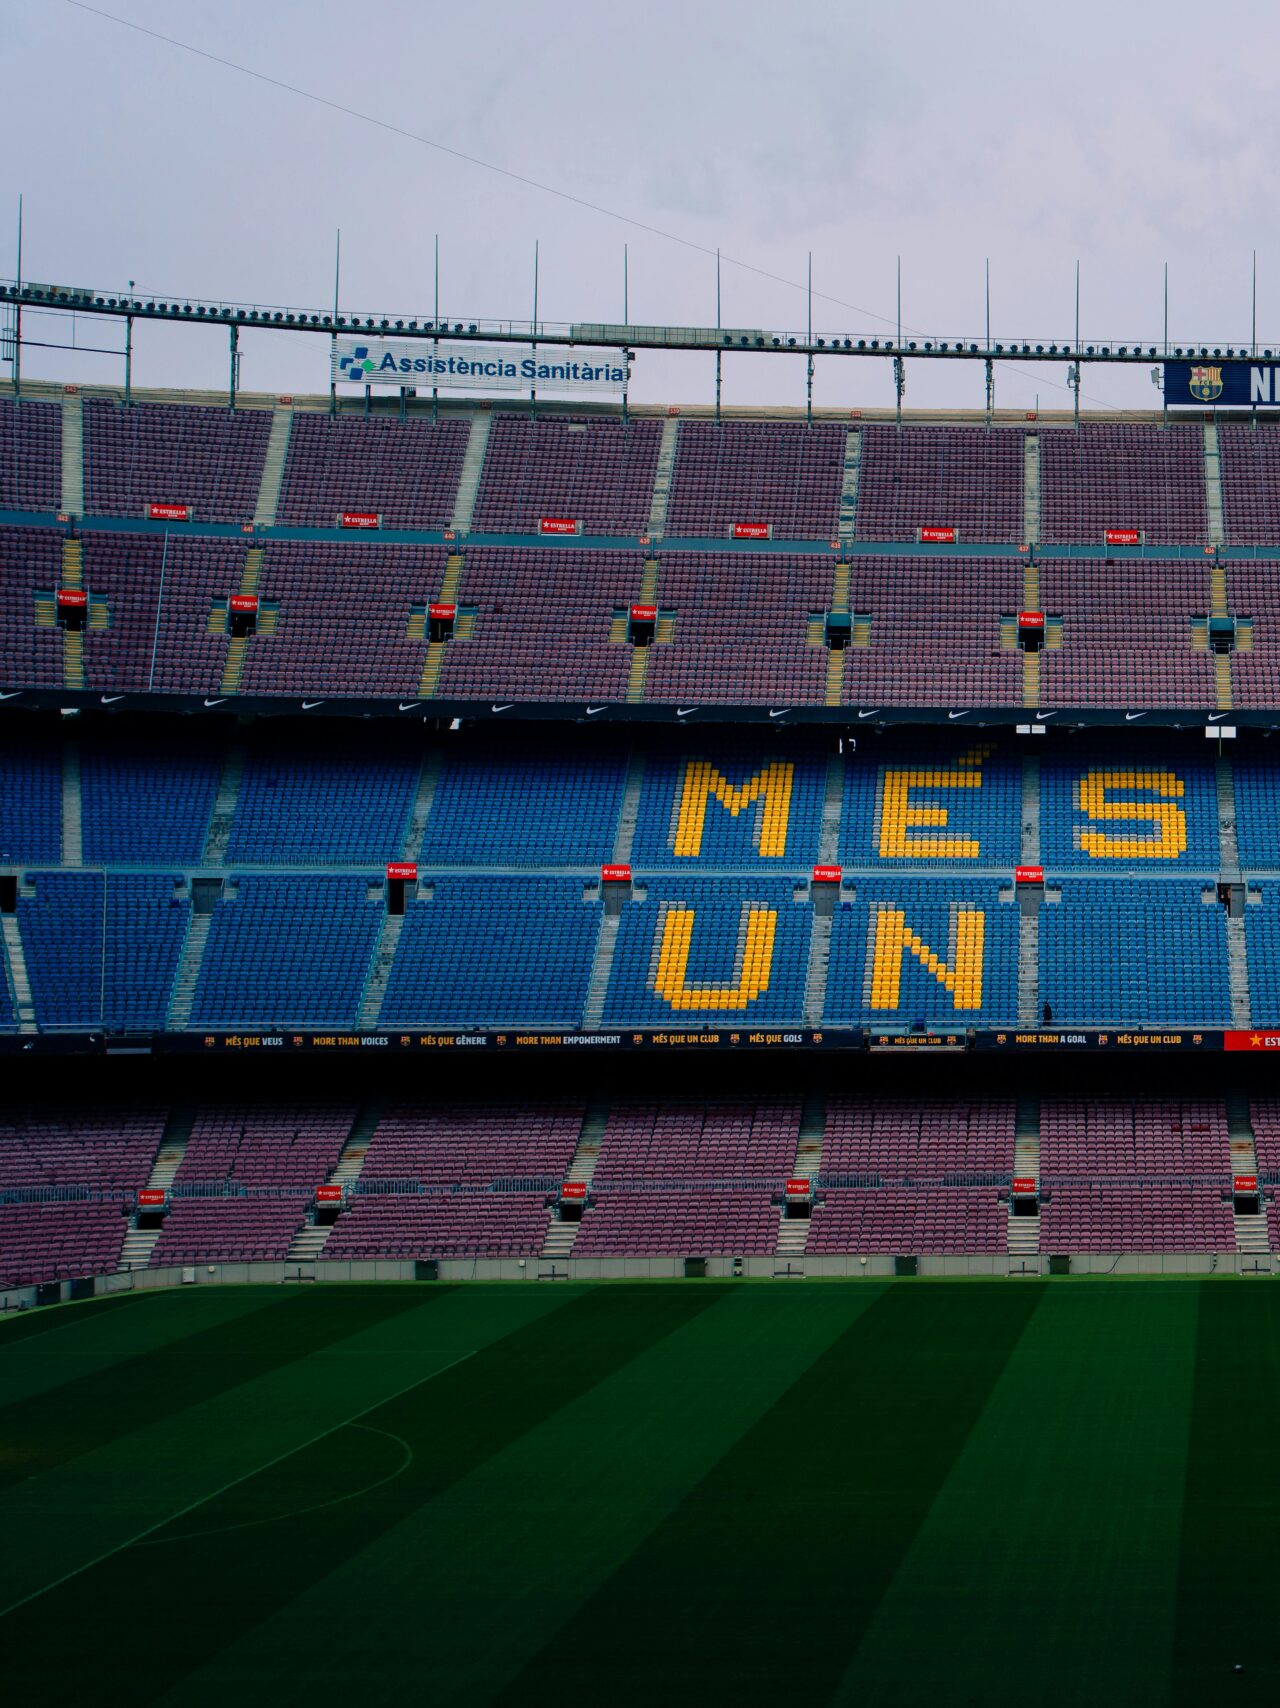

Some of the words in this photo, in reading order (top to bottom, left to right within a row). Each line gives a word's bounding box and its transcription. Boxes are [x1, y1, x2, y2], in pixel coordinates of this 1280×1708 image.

[379, 352, 516, 377] Assistència
[521, 359, 624, 382] Sanitària
[674, 745, 1187, 858] MÉS
[654, 910, 985, 1010] UN
[225, 1036, 241, 1046] MÉS
[243, 1037, 260, 1047] QUE
[261, 1037, 283, 1046] VEUS
[312, 1037, 337, 1046] MORE
[337, 1037, 360, 1046] THAN
[361, 1037, 389, 1046] VOICES
[420, 1035, 436, 1045] MÉS
[438, 1037, 455, 1046] QUE
[455, 1035, 487, 1045] GÈNERE
[516, 1036, 539, 1045] MORE
[540, 1036, 562, 1045] THAN
[562, 1036, 621, 1045] EMPOWERMENT
[652, 1034, 668, 1044] MÉS
[669, 1035, 686, 1045] QUE
[686, 1035, 699, 1044] UN
[699, 1035, 720, 1044] CLUB
[749, 1033, 765, 1043] MÉS
[766, 1034, 783, 1044] QUE
[783, 1034, 803, 1043] GOLS
[1015, 1035, 1039, 1044] MORE
[1039, 1035, 1059, 1044] THAN
[1060, 1035, 1066, 1044] A
[1067, 1035, 1088, 1044] GOAL
[1116, 1034, 1132, 1043] MÉS
[1133, 1035, 1150, 1045] QUE
[1150, 1035, 1162, 1044] UN
[1162, 1035, 1182, 1044] CLUB
